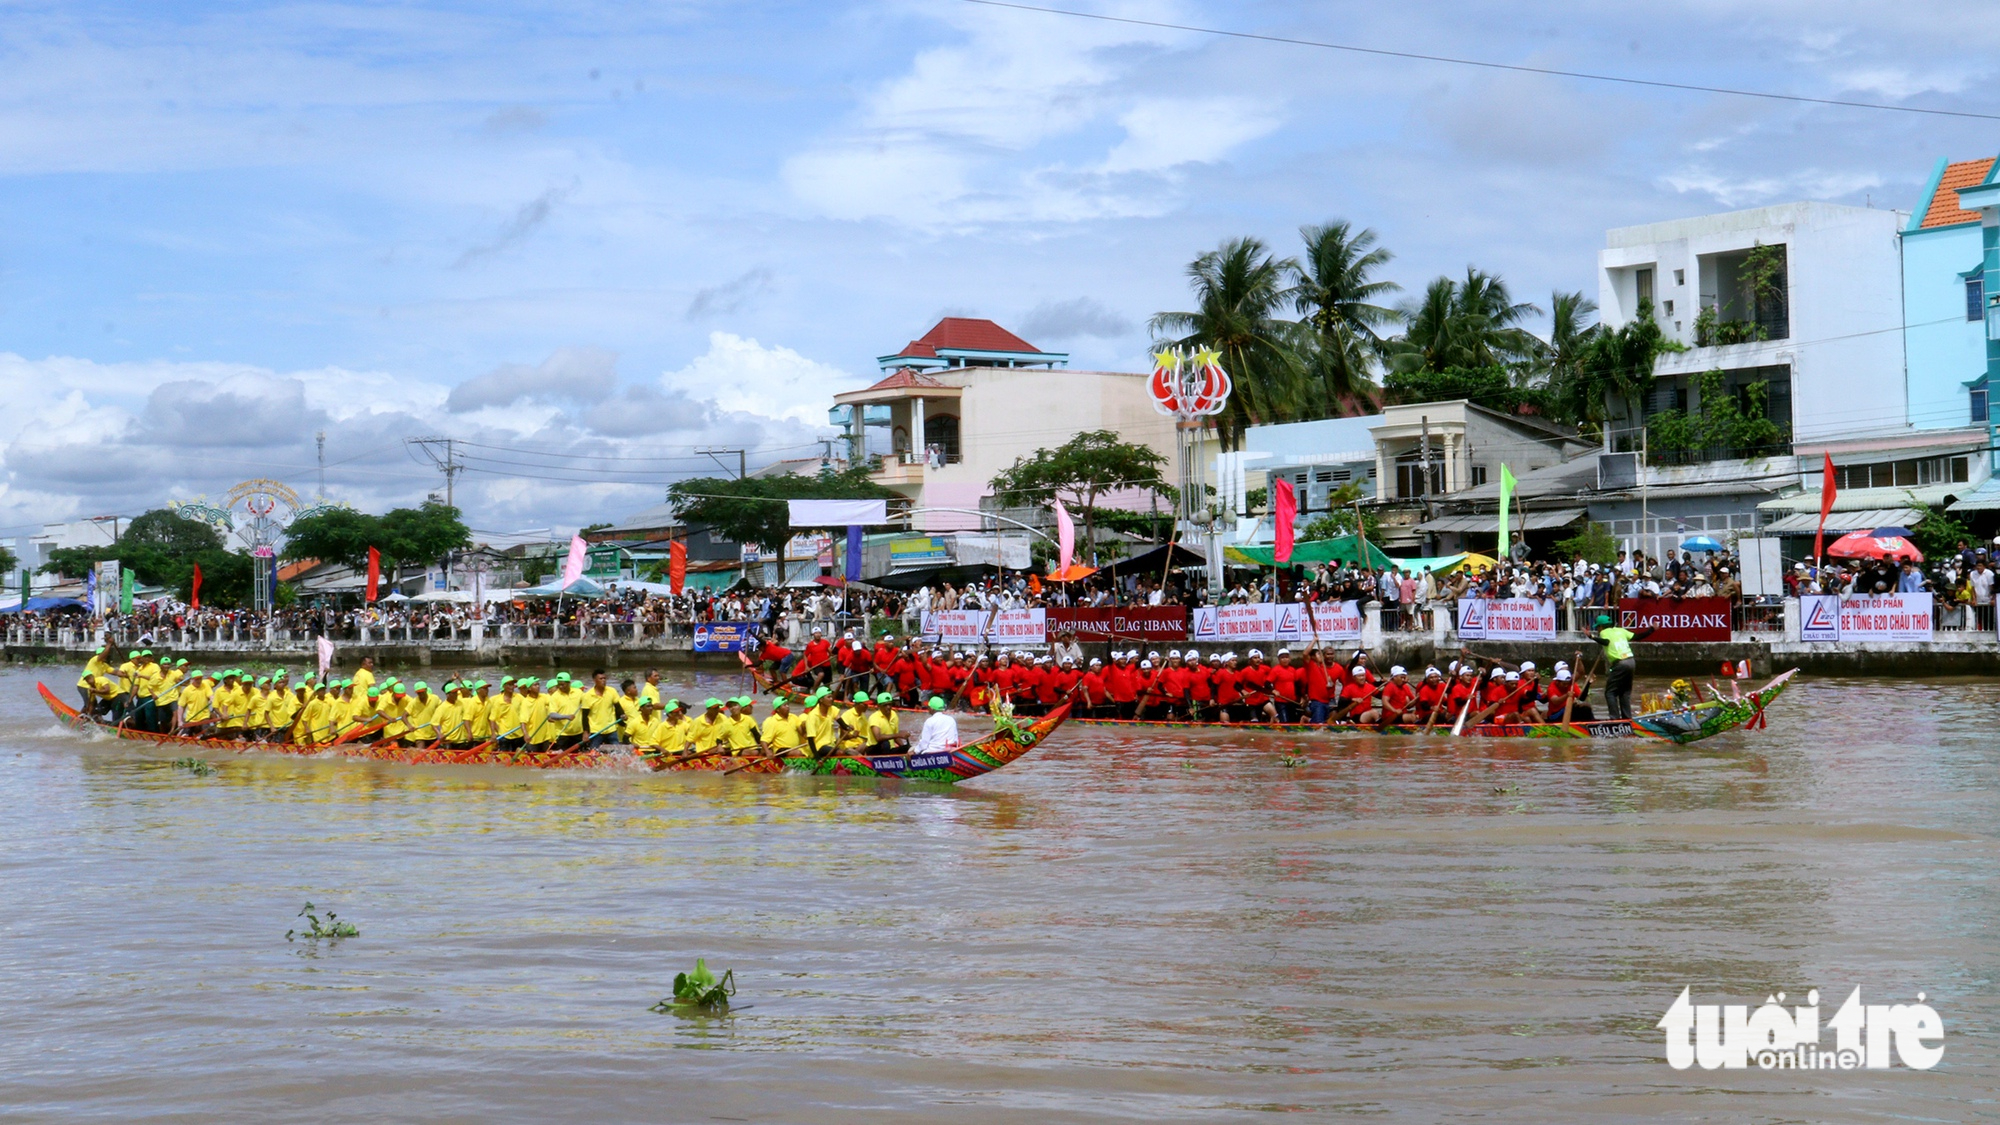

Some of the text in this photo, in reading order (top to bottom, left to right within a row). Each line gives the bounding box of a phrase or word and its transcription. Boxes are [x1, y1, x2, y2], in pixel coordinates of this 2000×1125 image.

[1503, 603, 1510, 611] TY
[1862, 600, 1870, 608] TY
[1057, 620, 1110, 632] AGRIBANK
[1496, 614, 1510, 630] TÔNG
[1512, 617, 1522, 630] 620
[1524, 614, 1539, 630] CHÂU
[1638, 614, 1727, 628] AGRIBANK
[1841, 612, 1850, 630] BÊ
[1852, 612, 1872, 630] TÔNG
[1874, 615, 1888, 630] 620
[1890, 611, 1910, 630] CHÂU
[1240, 621, 1248, 634] 620
